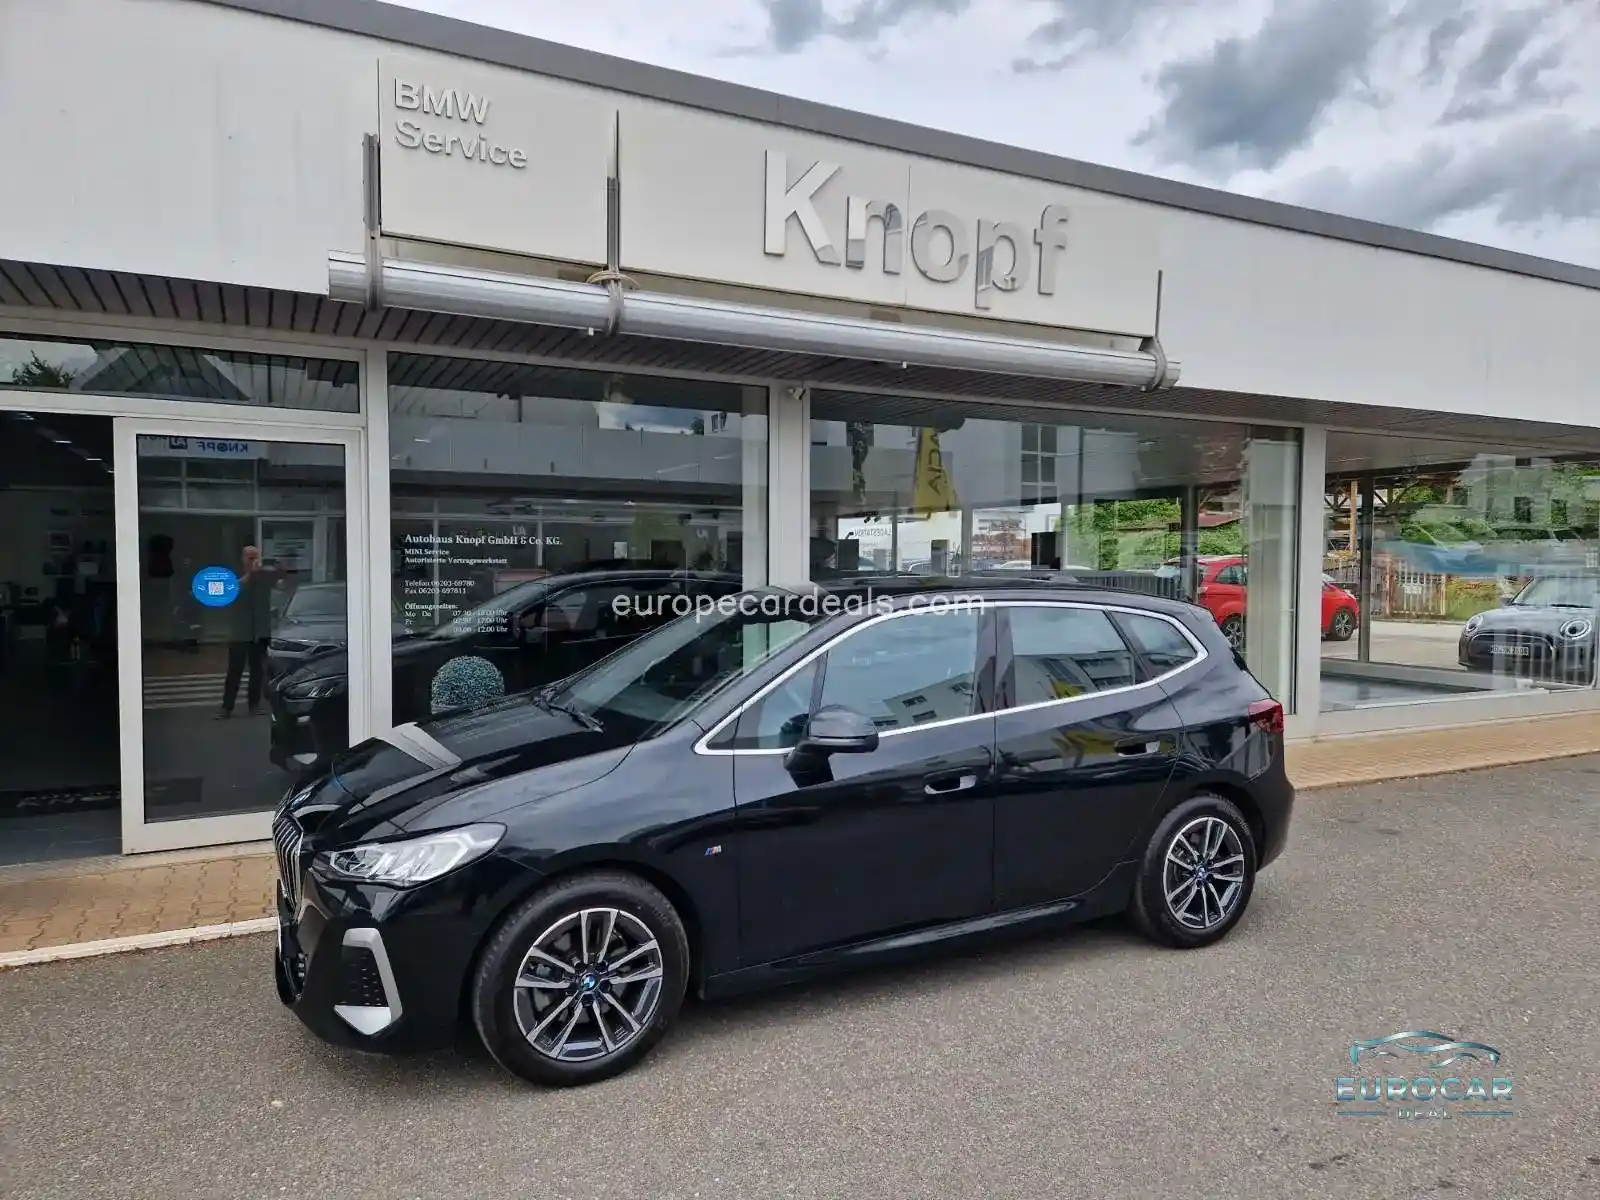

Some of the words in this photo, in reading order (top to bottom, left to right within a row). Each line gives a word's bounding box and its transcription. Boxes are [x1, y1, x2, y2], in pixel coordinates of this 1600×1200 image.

[394, 78, 491, 125] BMW
[395, 118, 528, 169] Service
[763, 149, 1070, 310] Knopf
[404, 534, 453, 544] Autohaus
[455, 535, 486, 547] Knopf
[488, 536, 518, 545] GmbH
[520, 536, 527, 545] &
